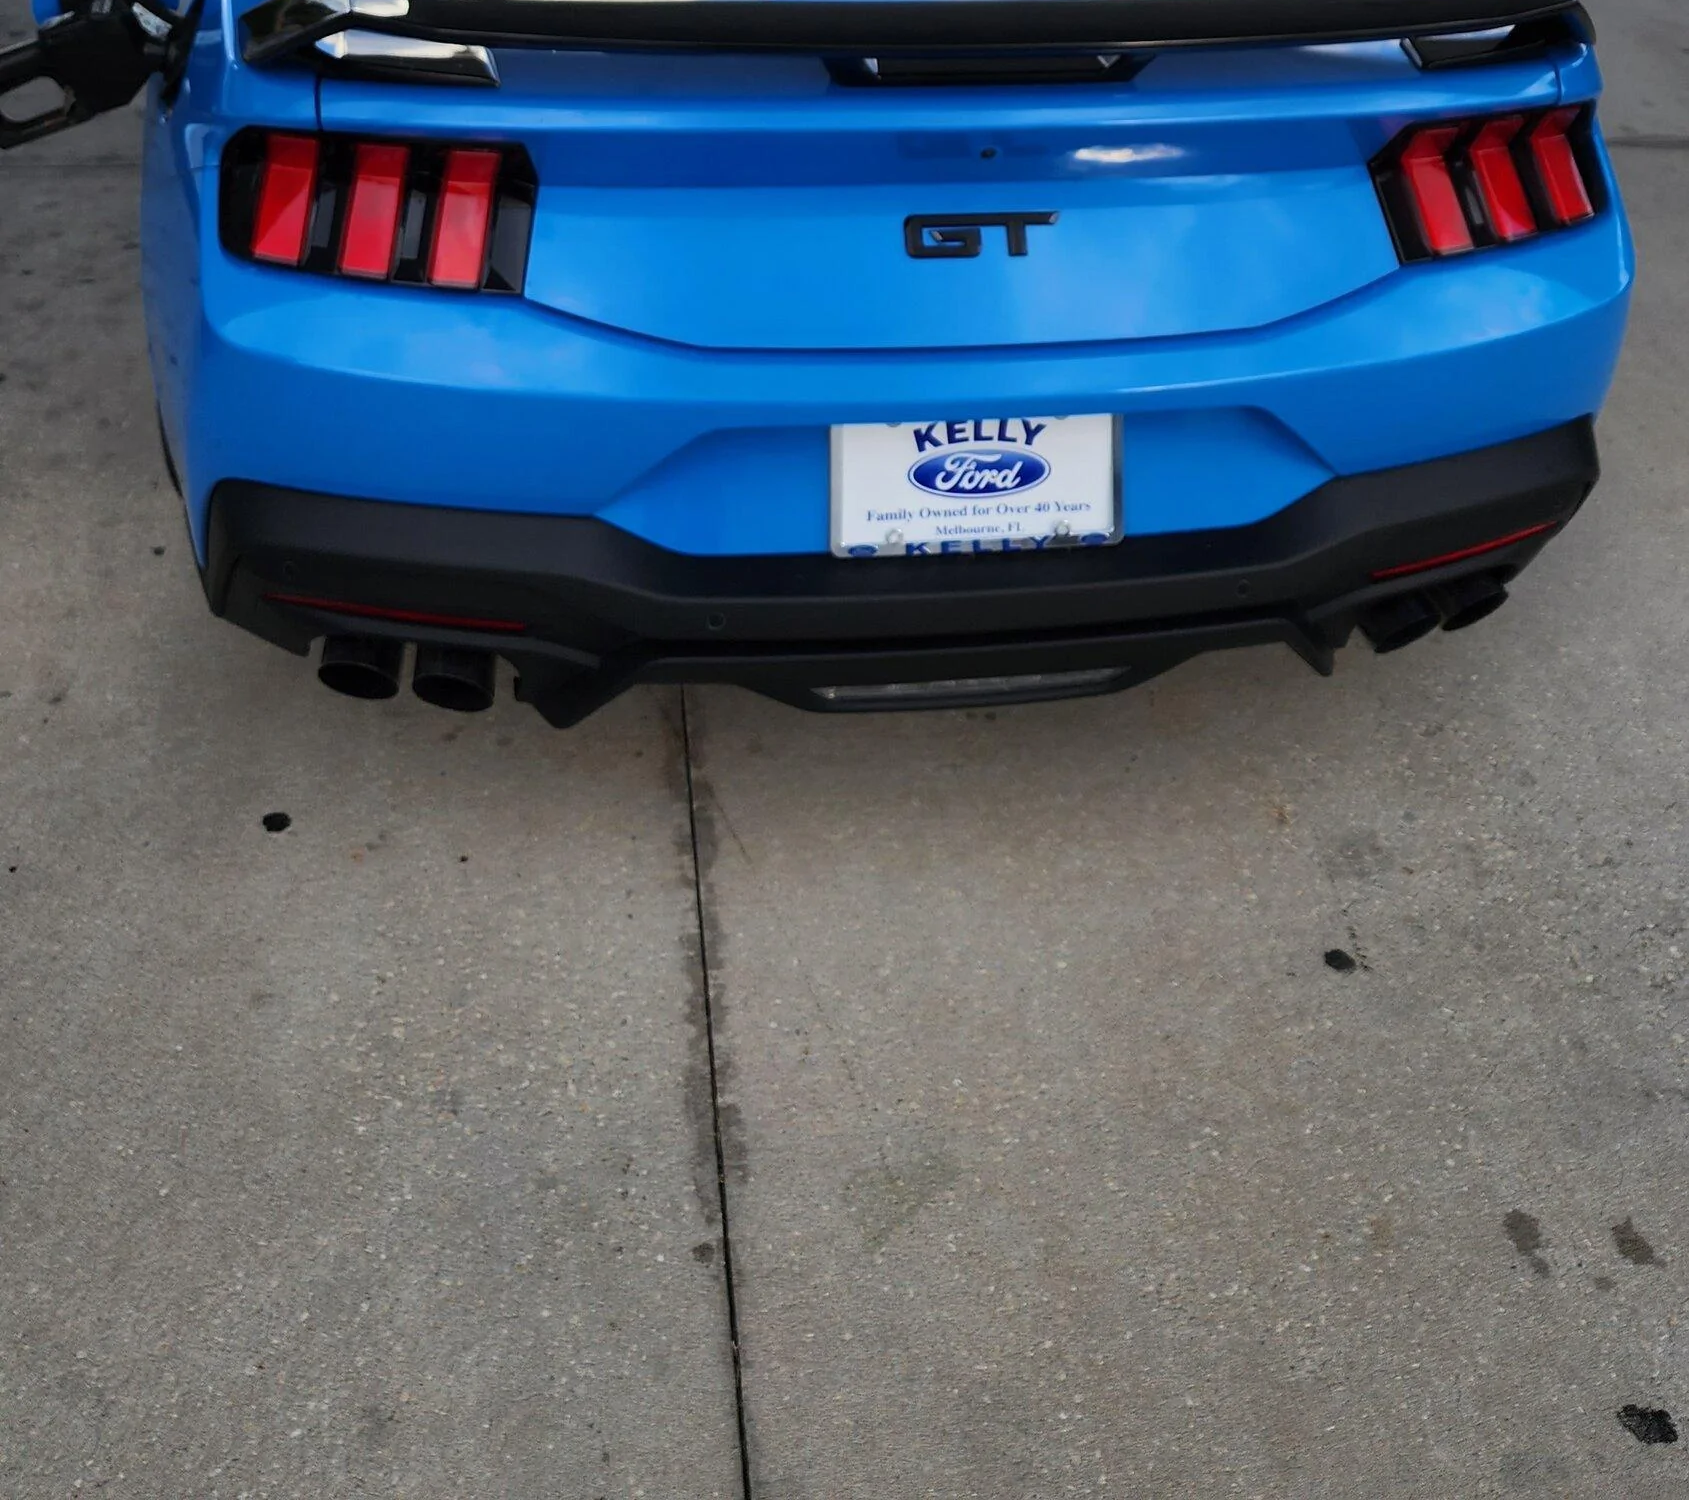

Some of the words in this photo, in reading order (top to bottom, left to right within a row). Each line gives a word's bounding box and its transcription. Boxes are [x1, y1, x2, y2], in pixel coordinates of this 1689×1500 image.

[903, 210, 1060, 259] GT
[913, 418, 1047, 453] KELLY
[935, 452, 1022, 492] Ford
[867, 508, 913, 523] Family
[919, 505, 968, 519] Owned
[972, 503, 993, 516] for
[997, 502, 1031, 515] Over
[1034, 501, 1051, 513] 40
[1055, 499, 1092, 513] Years
[935, 524, 1005, 536] Melbourne,
[905, 535, 1051, 556] KELLY
